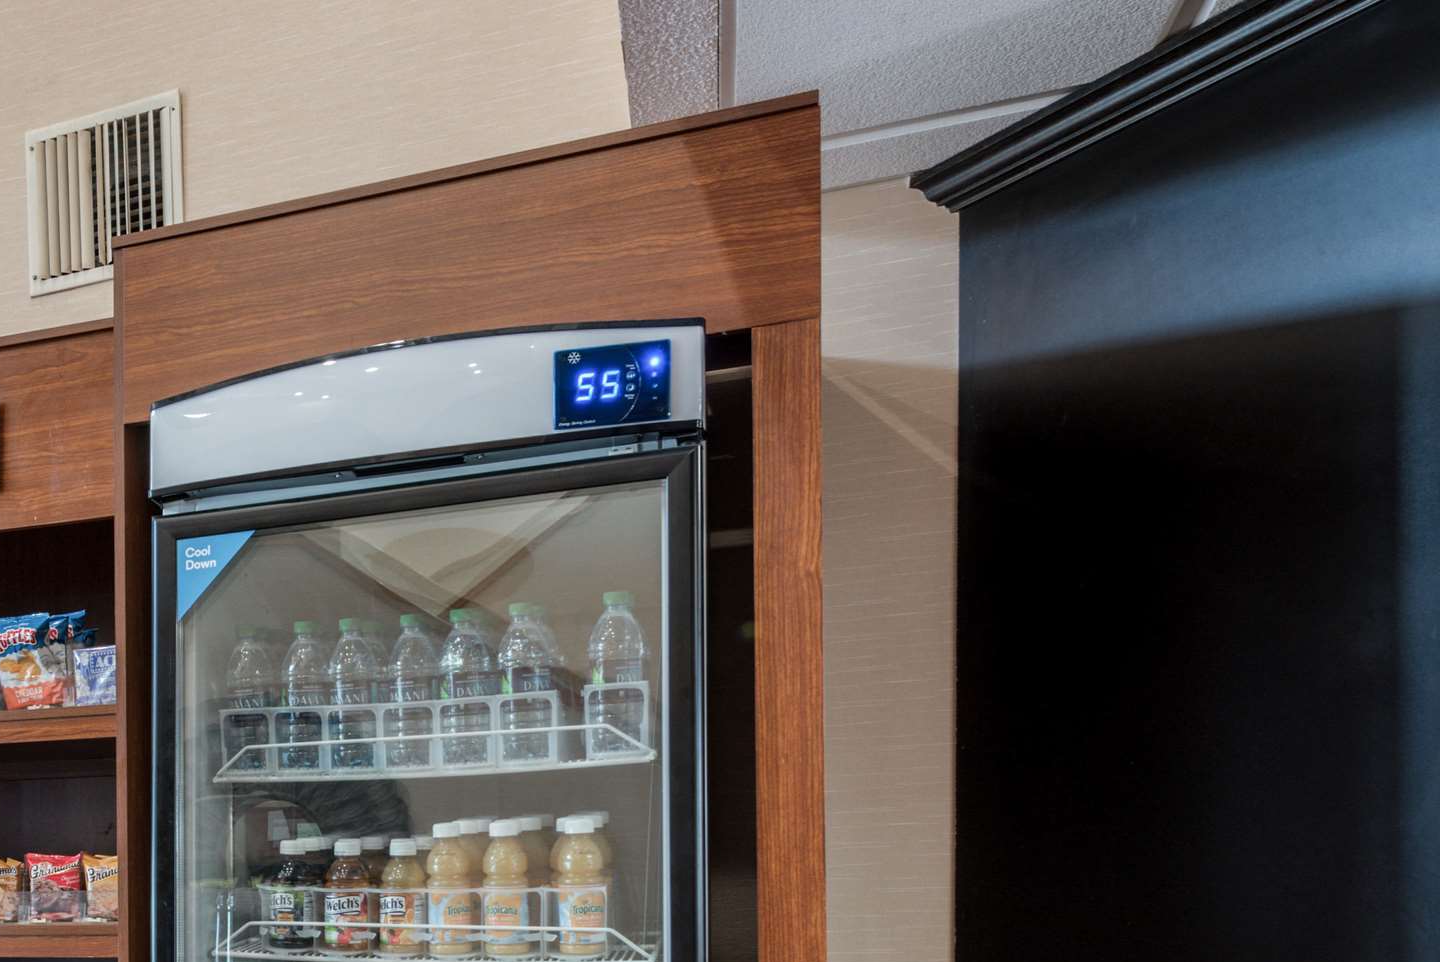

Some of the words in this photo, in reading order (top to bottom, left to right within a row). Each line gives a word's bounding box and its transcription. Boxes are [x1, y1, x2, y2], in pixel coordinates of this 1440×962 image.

[575, 369, 621, 402] 55
[185, 545, 211, 558] Cool
[185, 559, 217, 571] Down
[326, 897, 361, 911] Welch's
